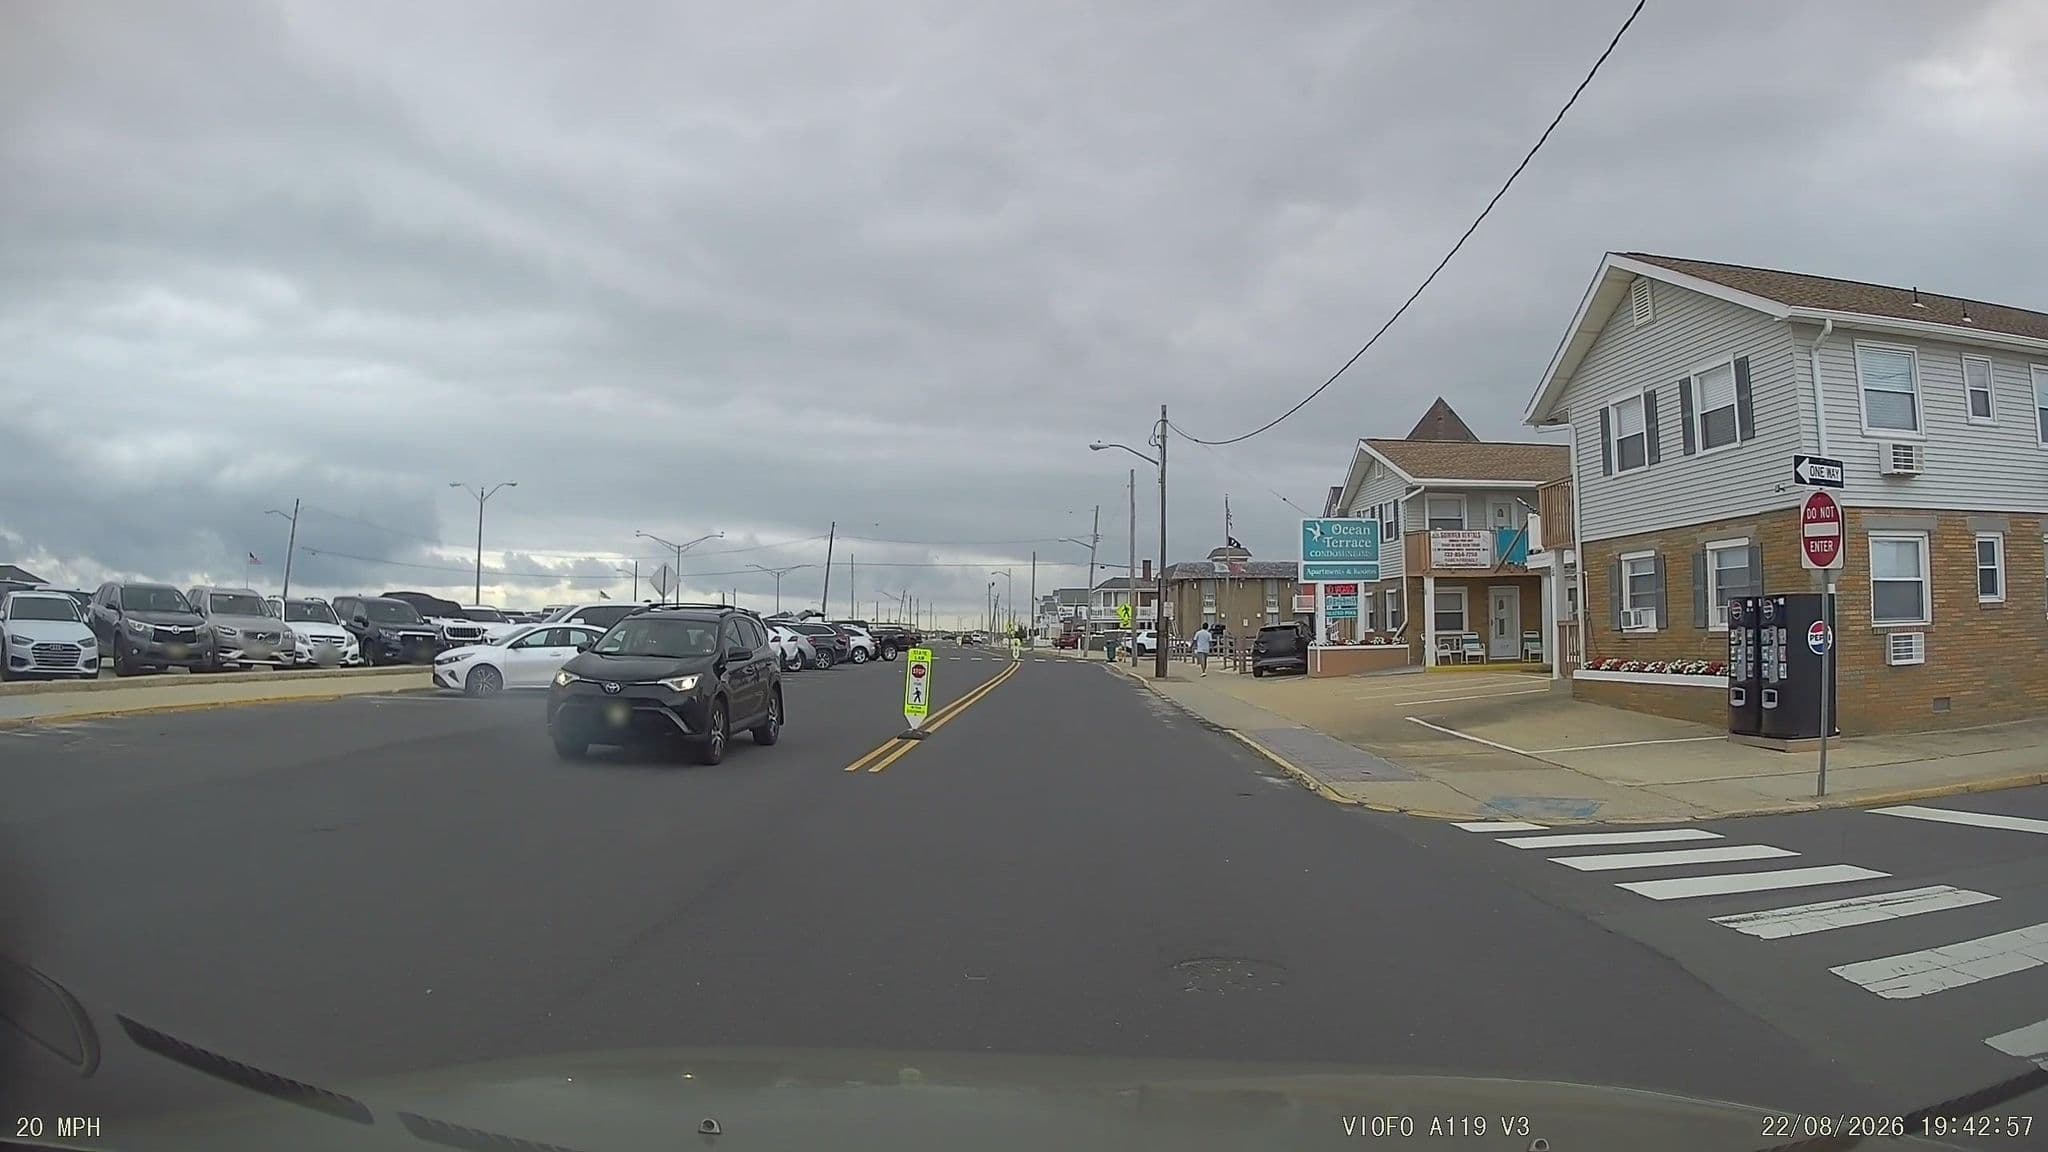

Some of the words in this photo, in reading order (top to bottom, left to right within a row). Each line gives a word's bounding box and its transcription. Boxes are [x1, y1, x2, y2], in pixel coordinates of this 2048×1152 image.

[1810, 466, 1824, 478] ONE
[1826, 468, 1840, 480] WAY
[1807, 507, 1816, 519] DO
[1820, 506, 1835, 519] NOT
[1331, 523, 1371, 535] Ocean
[1322, 536, 1372, 548] Terrace
[1810, 541, 1833, 553] ENTER
[912, 667, 926, 675] STOP
